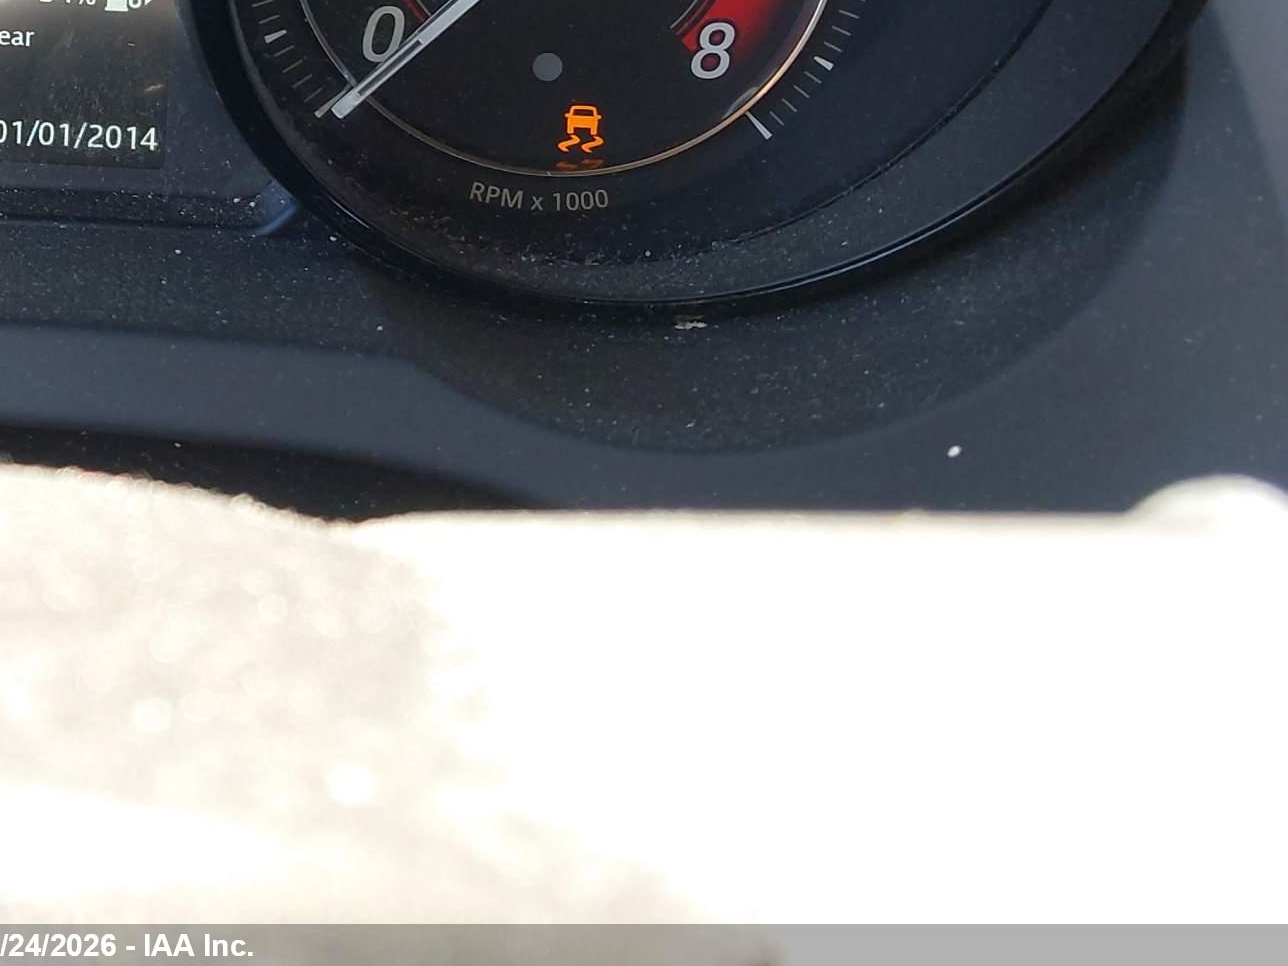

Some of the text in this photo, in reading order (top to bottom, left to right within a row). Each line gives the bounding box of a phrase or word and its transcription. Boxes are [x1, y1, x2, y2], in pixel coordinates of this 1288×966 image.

[362, 5, 406, 62] 0
[689, 20, 736, 80] 8
[469, 182, 609, 211] RPM x 1000
